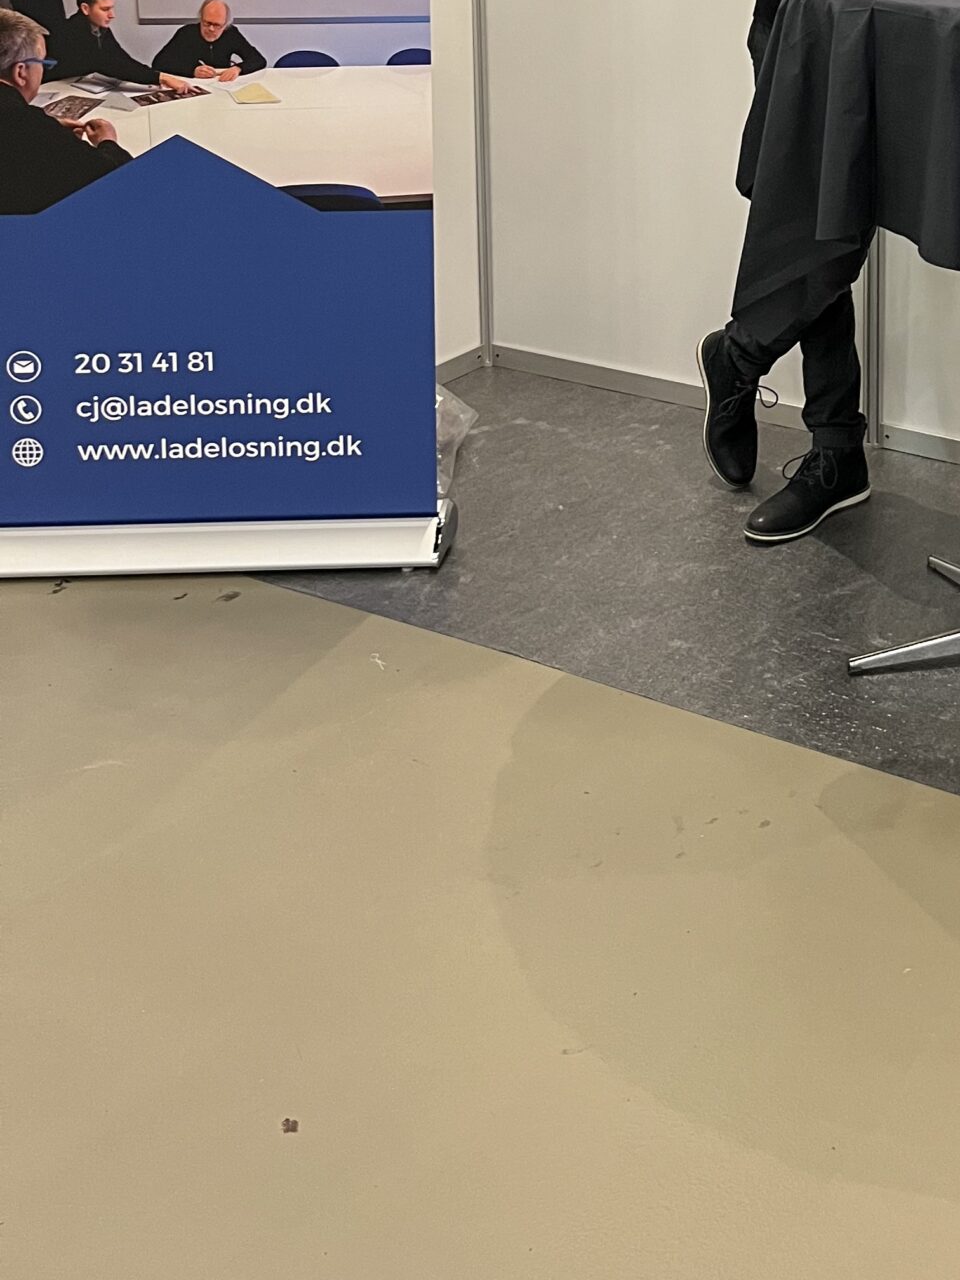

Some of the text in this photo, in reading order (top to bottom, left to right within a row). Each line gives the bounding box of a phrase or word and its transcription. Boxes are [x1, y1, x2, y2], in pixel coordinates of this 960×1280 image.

[74, 351, 215, 375] 20 31 41 81
[76, 392, 332, 423] cj@ladelosning.dk
[77, 435, 362, 462] www.ladelosning.dk
